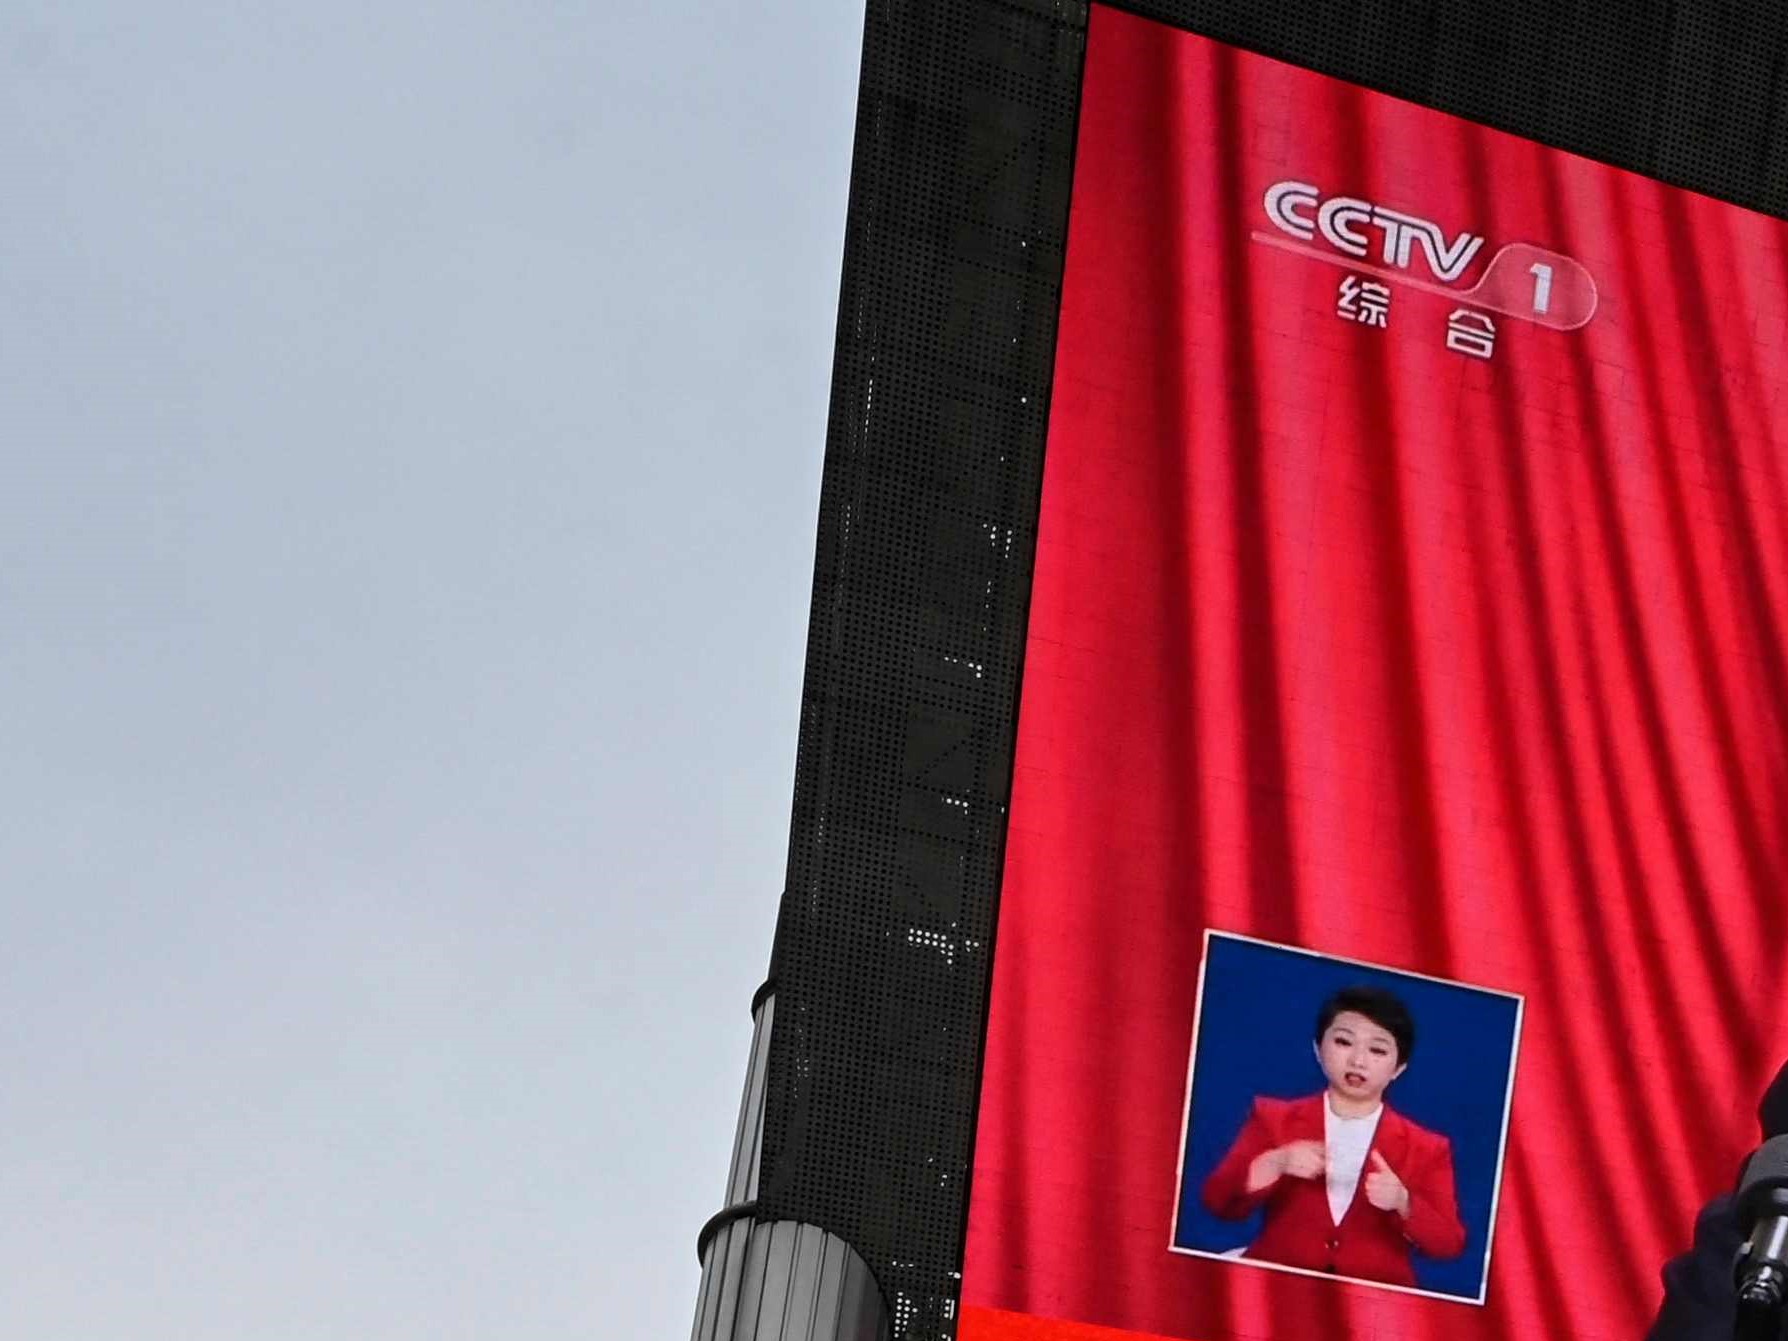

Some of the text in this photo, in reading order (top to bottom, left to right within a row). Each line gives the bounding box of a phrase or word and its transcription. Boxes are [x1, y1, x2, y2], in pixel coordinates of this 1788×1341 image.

[1263, 181, 1554, 314] CCTV 1
[1337, 275, 1495, 359] 综合
